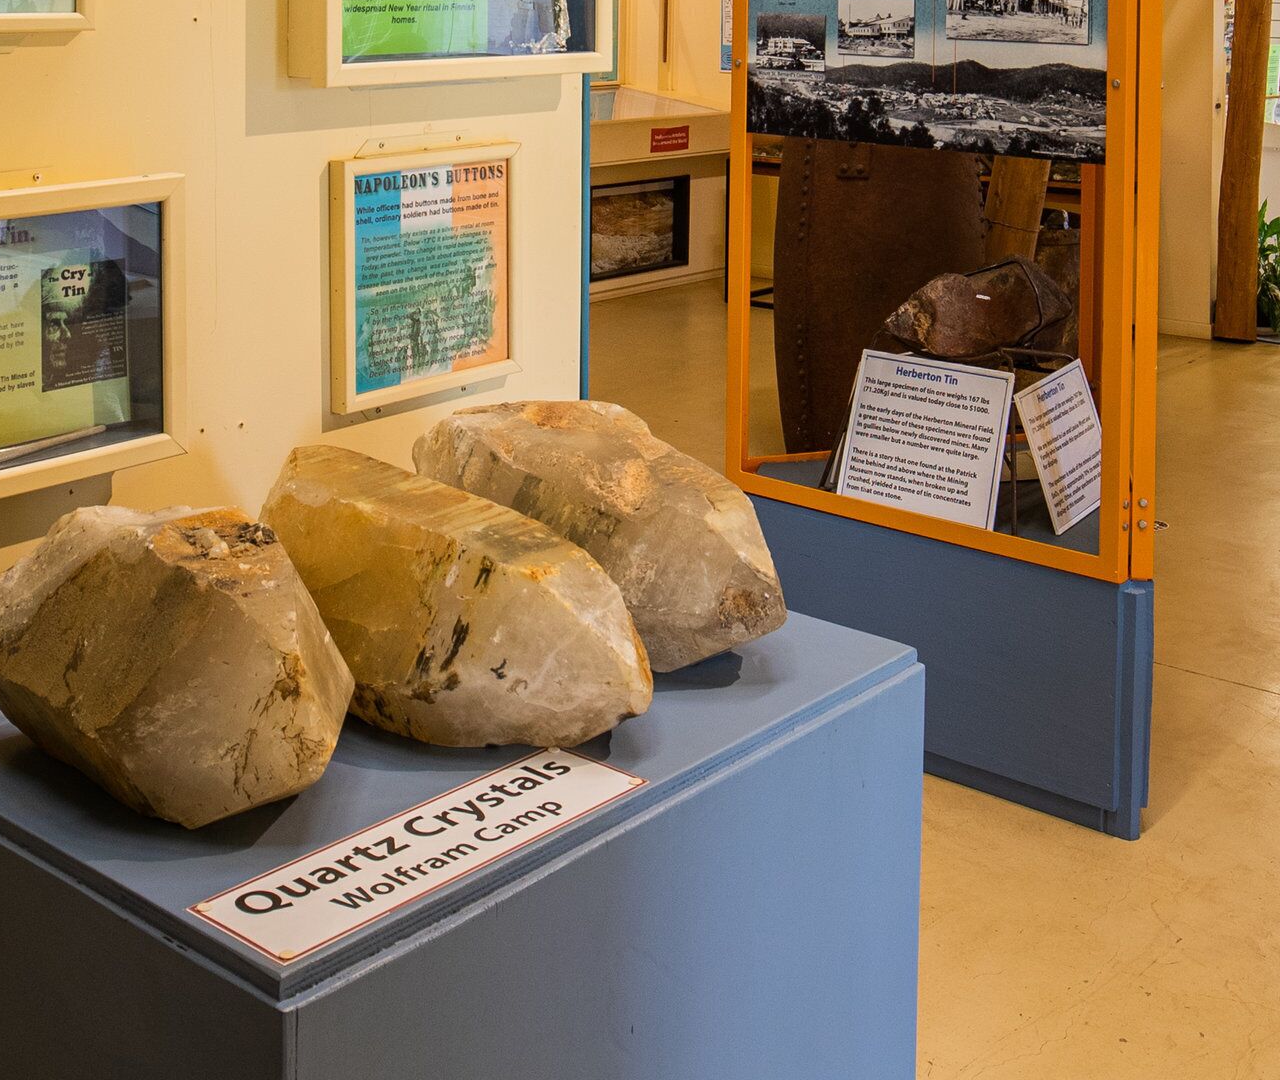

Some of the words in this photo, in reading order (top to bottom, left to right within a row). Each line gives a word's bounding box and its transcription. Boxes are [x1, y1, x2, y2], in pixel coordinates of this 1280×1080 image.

[354, 171, 439, 195] NAPOLEON'S
[445, 163, 503, 184] BUTTONS
[356, 205, 375, 215] While
[376, 202, 399, 212] officers
[401, 199, 413, 209] had
[414, 197, 437, 207] buttons
[439, 195, 455, 204] made
[456, 193, 470, 202] from
[472, 191, 487, 200] bone
[489, 189, 498, 198] and
[60, 268, 86, 281] Cry
[61, 284, 85, 297] Tin
[896, 365, 941, 383] Herberton
[944, 373, 958, 386] Tin
[865, 375, 875, 384] This
[876, 377, 890, 388] large
[892, 382, 918, 392] specimen
[926, 386, 934, 395] tin
[935, 389, 945, 397] ore
[946, 391, 967, 401] weighs
[968, 394, 979, 403] 167
[980, 396, 989, 404] lbs
[890, 390, 900, 398] and
[901, 391, 906, 399] is
[907, 393, 927, 403] valued
[927, 396, 944, 408] today
[945, 399, 960, 408] close
[961, 402, 968, 410] to
[969, 403, 989, 414] $1000.
[233, 835, 410, 916] Quartz
[403, 758, 571, 838] Crystals
[328, 842, 477, 911] Wolfram
[473, 799, 562, 840] Camp
